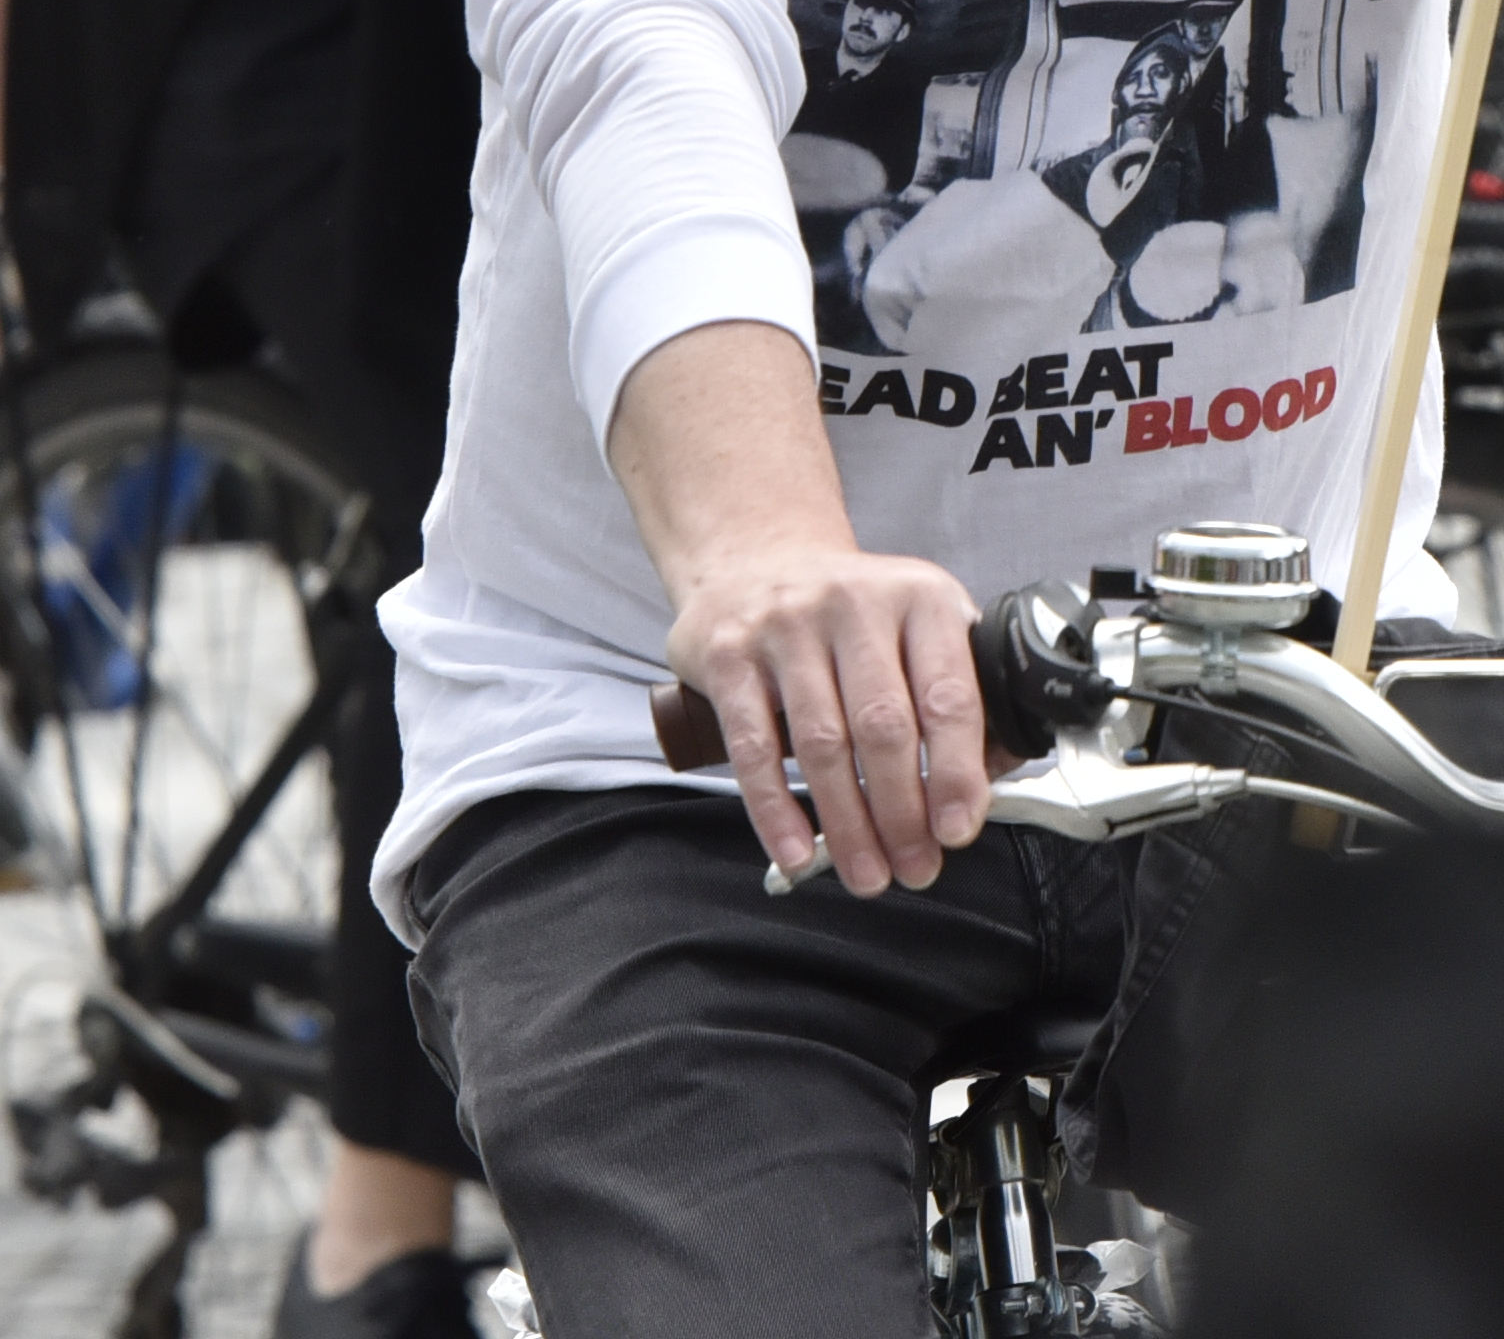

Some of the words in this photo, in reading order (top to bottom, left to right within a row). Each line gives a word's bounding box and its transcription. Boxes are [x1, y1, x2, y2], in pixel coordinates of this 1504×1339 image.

[820, 363, 977, 428] EAD
[986, 342, 1174, 421] BEAT
[968, 408, 1115, 475] AN'
[1124, 366, 1337, 454] BLOOD
